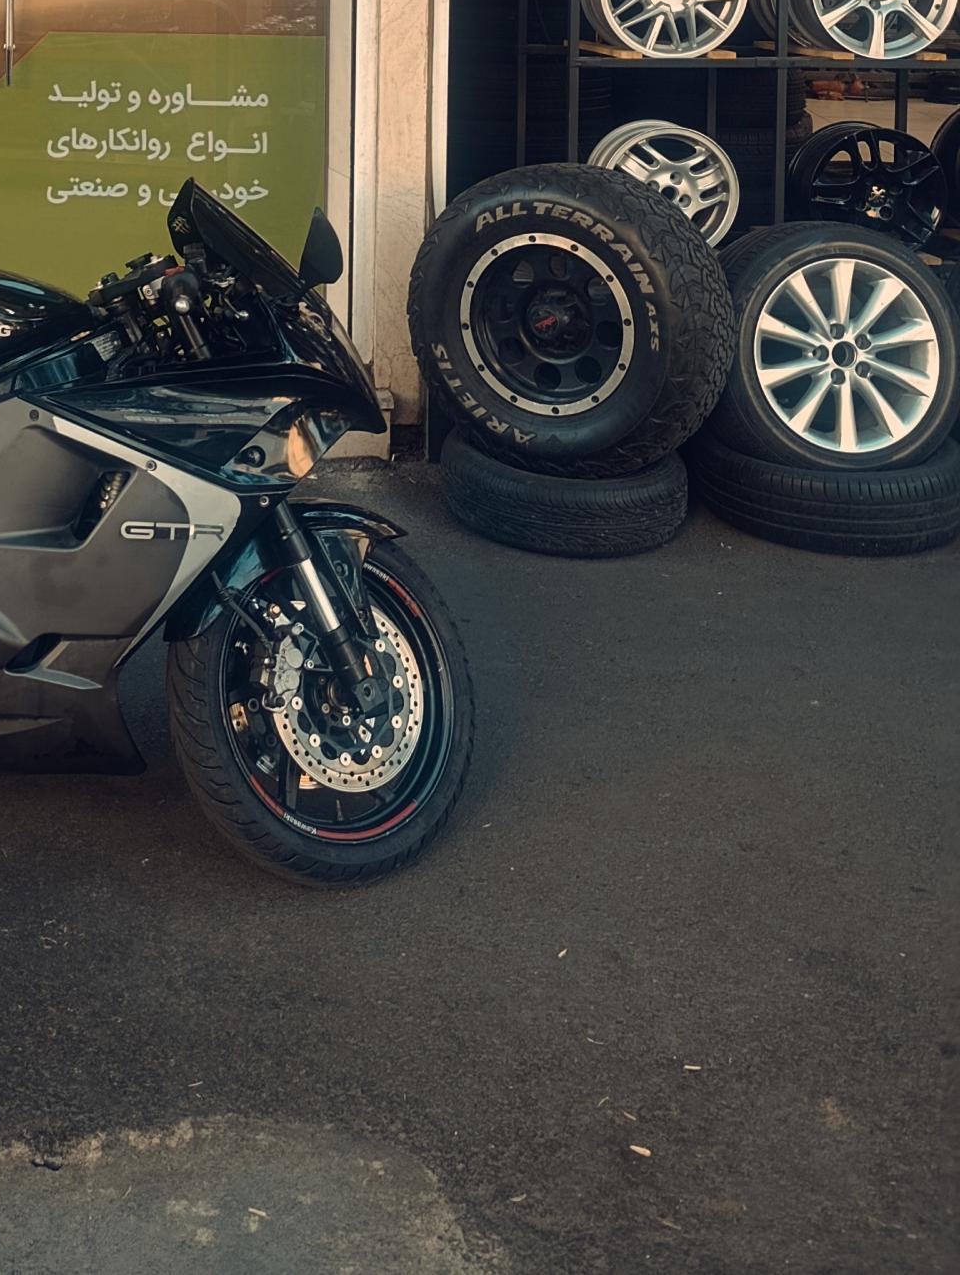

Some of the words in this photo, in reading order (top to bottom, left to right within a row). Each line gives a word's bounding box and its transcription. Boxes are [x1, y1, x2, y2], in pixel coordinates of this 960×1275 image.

[48, 80, 121, 111] تولید
[127, 91, 141, 113] و
[148, 82, 269, 114] مشاوره
[47, 127, 171, 161] روانکارهای
[186, 130, 268, 161] انواع
[46, 175, 129, 204] صنعتی
[137, 183, 152, 206] و
[475, 202, 529, 233] ALL
[533, 201, 656, 295] TERRAIN
[120, 520, 225, 541] GTR
